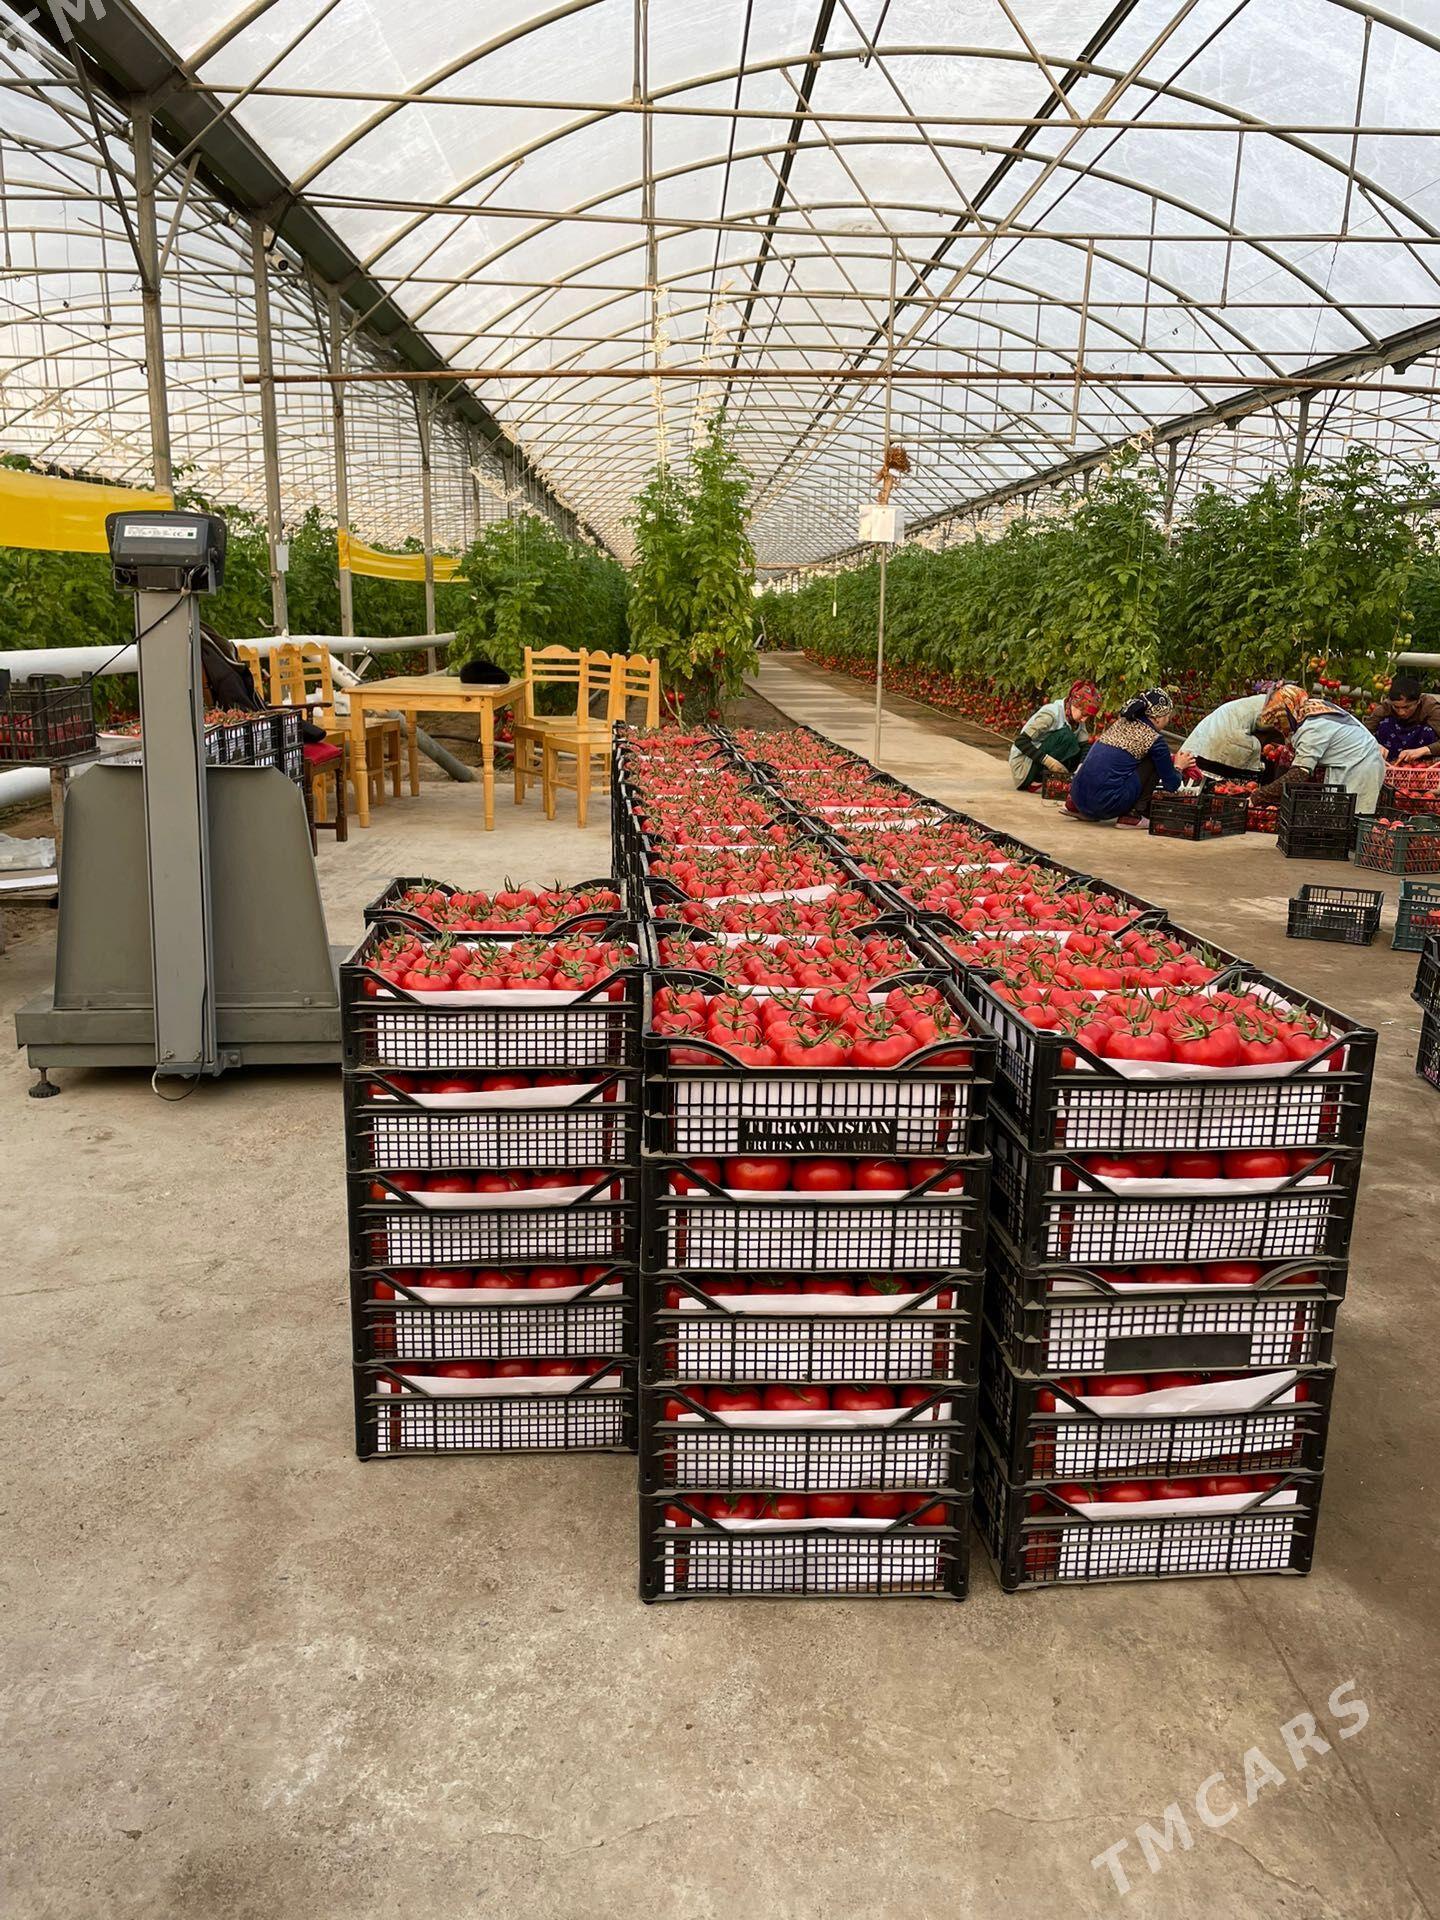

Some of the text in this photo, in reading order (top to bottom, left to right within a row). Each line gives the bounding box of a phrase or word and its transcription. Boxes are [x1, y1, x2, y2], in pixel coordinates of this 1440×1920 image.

[745, 1120, 892, 1135] TURKMENISTAN
[745, 1140, 793, 1151] FRUITS
[796, 1140, 805, 1151] &
